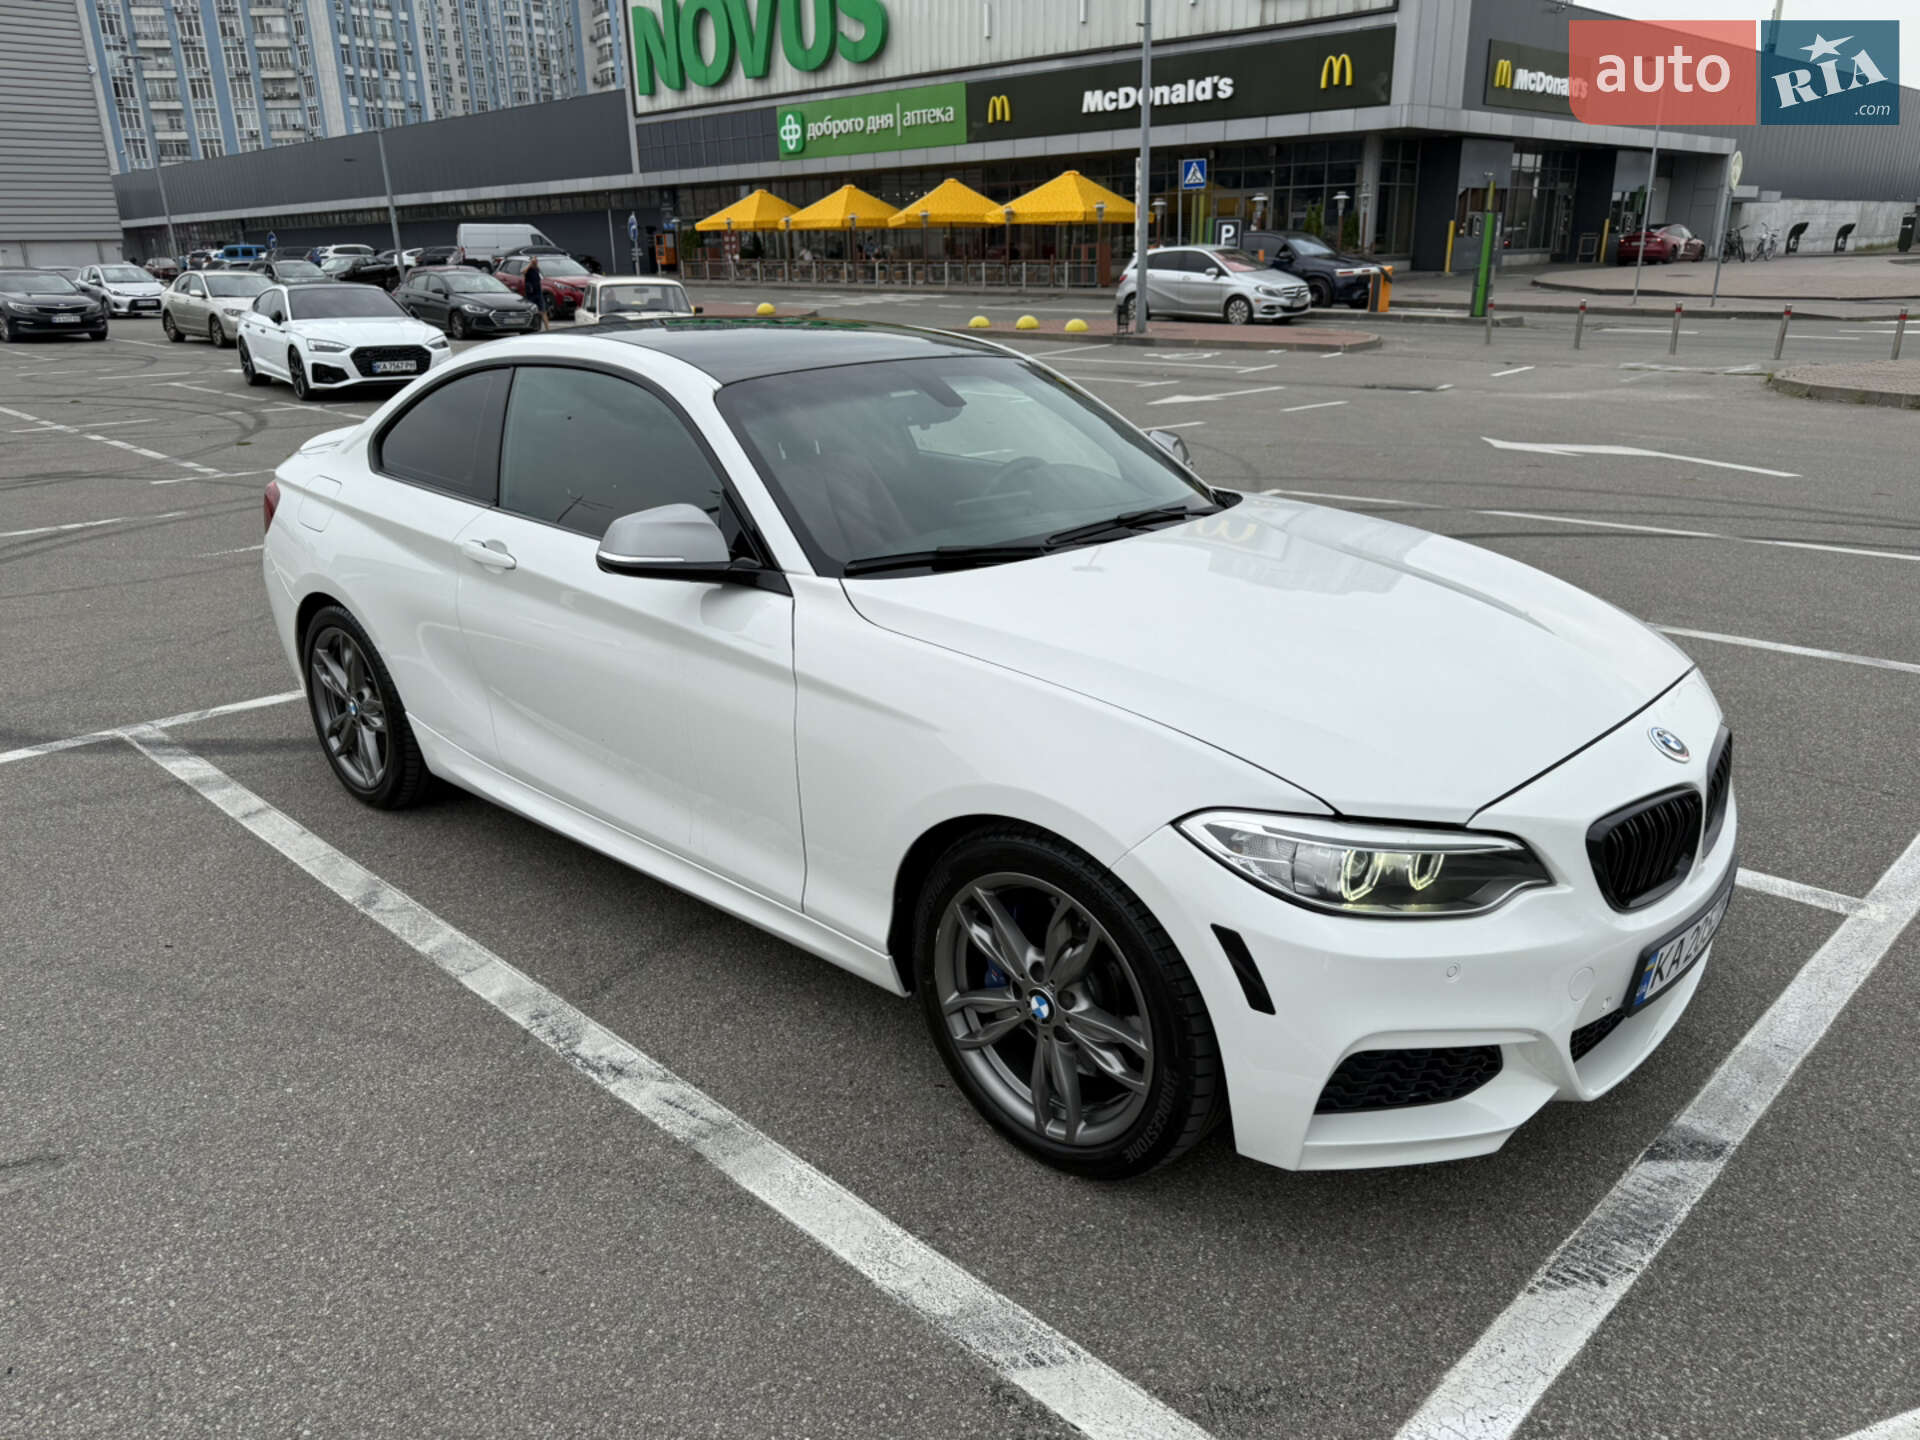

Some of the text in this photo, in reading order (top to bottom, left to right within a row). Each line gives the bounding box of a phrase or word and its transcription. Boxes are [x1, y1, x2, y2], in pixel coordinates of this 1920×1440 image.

[632, 0, 888, 96] NOVUS
[807, 106, 955, 140] доброго дня аптека
[1221, 224, 1235, 246] P
[1650, 937, 1686, 988] KA
